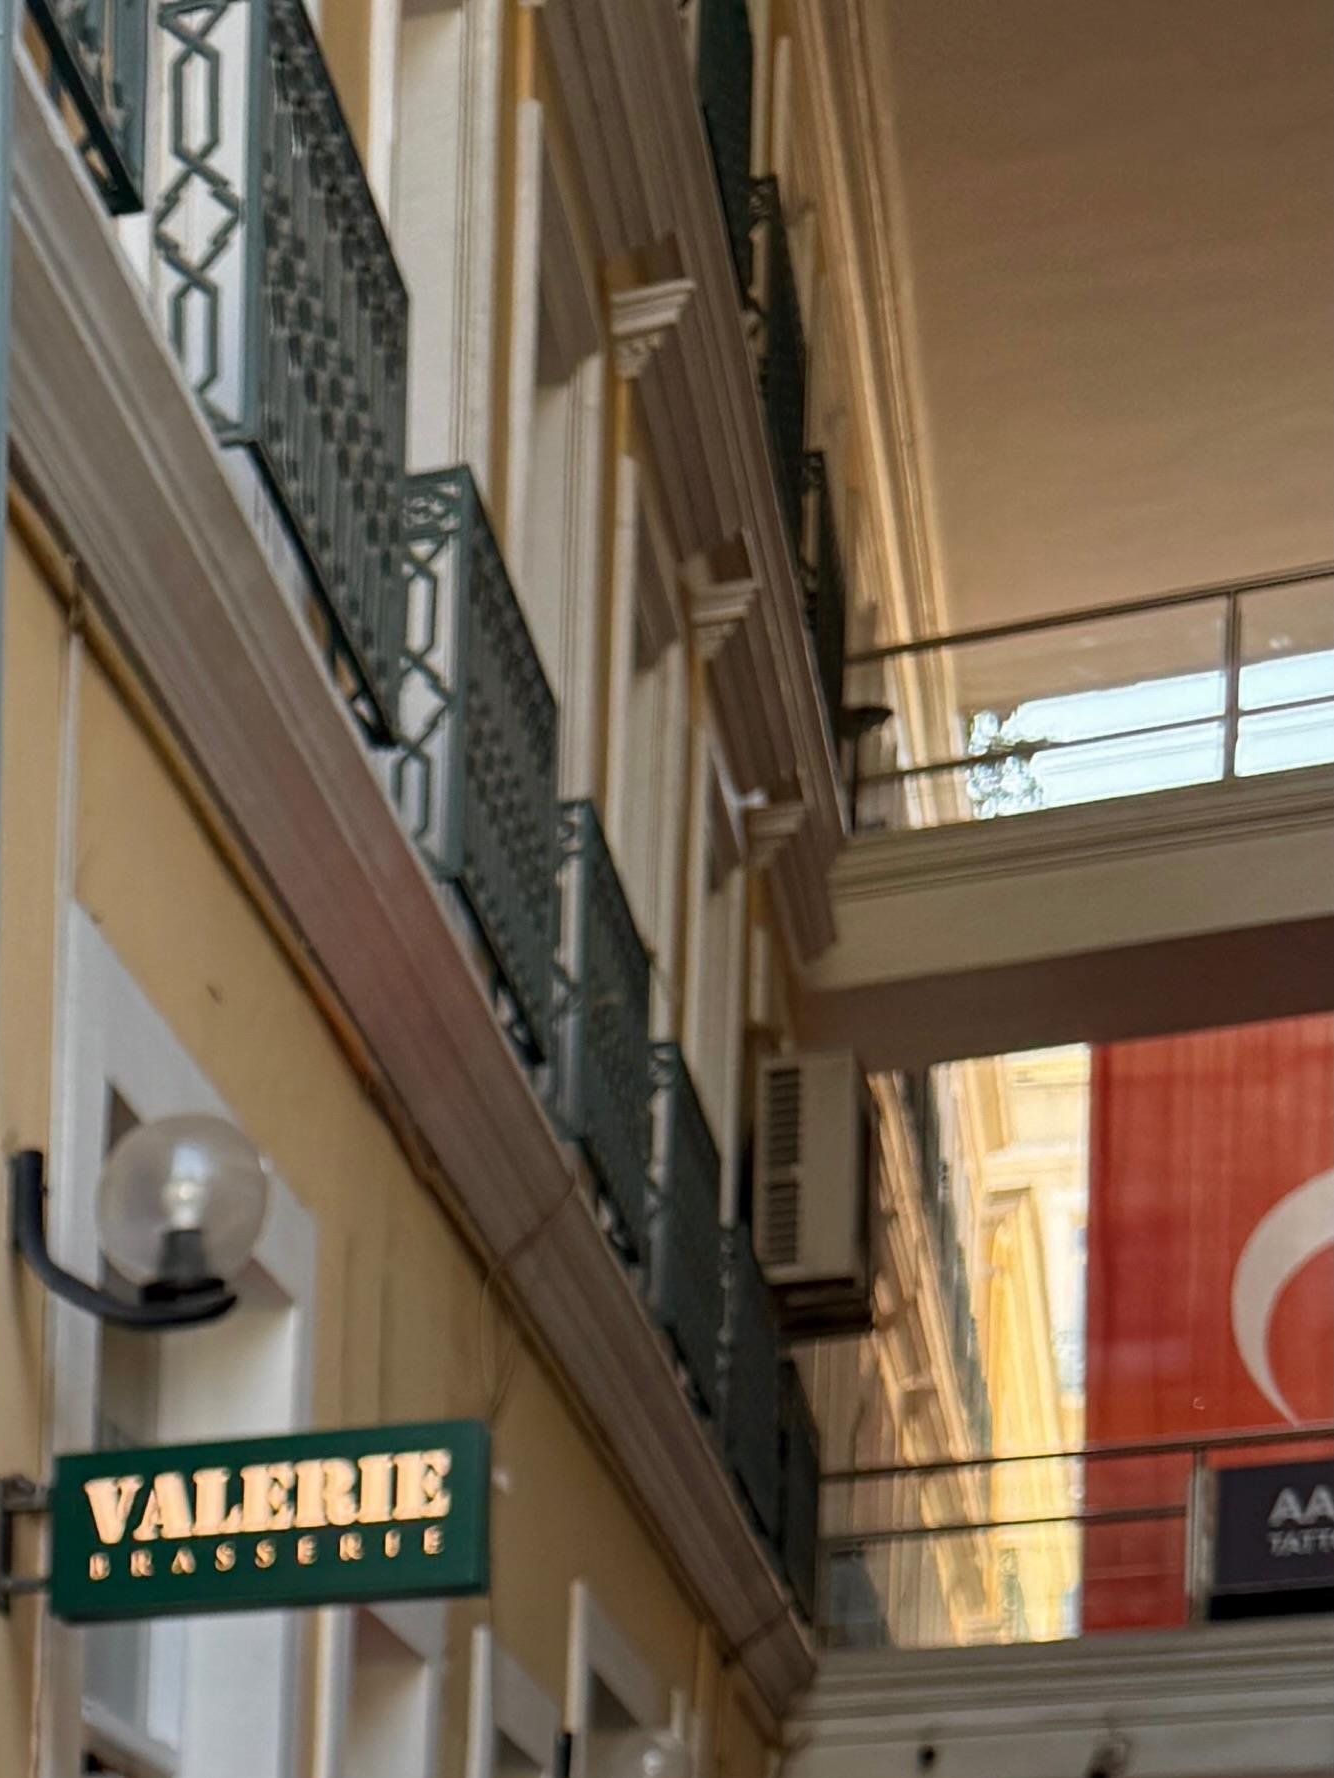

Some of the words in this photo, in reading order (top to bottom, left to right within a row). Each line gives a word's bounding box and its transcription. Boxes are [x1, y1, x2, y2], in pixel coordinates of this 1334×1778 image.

[84, 1448, 452, 1544] VALERIE
[89, 1525, 445, 1581] BRASSERIE
[1268, 1527, 1334, 1557] TATT
